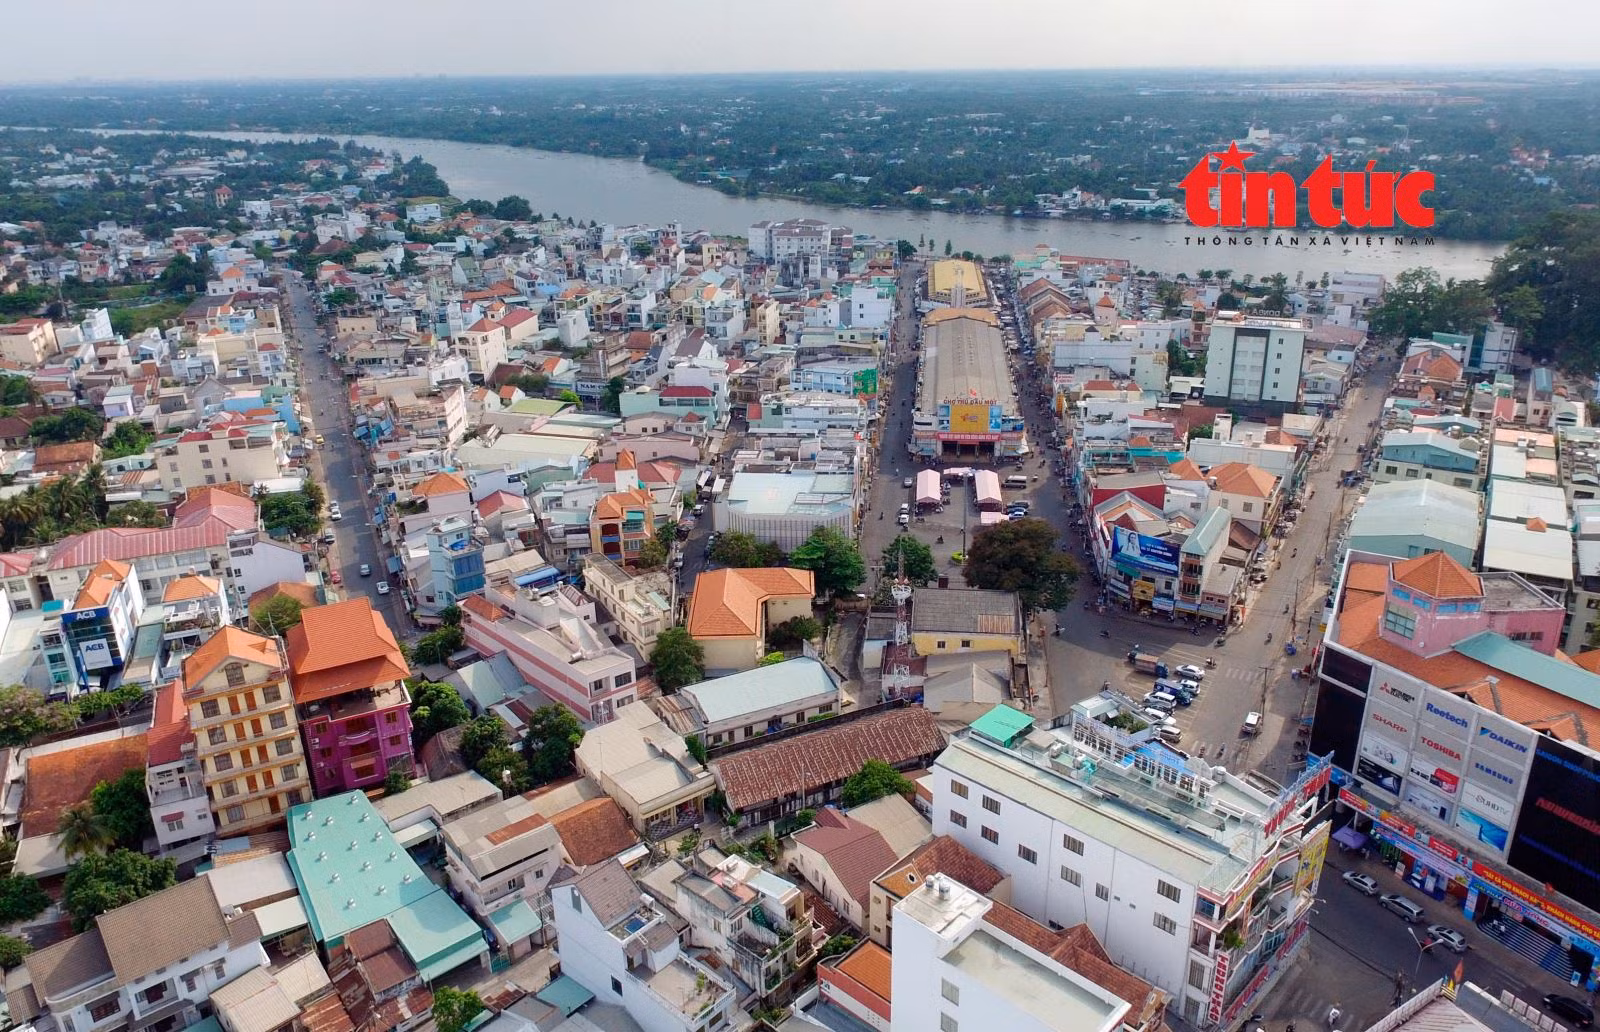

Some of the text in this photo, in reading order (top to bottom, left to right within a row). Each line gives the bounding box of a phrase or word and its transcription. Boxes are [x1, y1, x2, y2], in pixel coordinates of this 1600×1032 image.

[76, 610, 97, 620] ACB
[85, 643, 105, 652] ACB
[1372, 713, 1408, 733] SHARP
[1426, 702, 1468, 728] Reetech
[1420, 736, 1462, 761] TOSHIBA
[1488, 731, 1528, 753] DAIKIN
[1475, 762, 1514, 785] SAMSUNG
